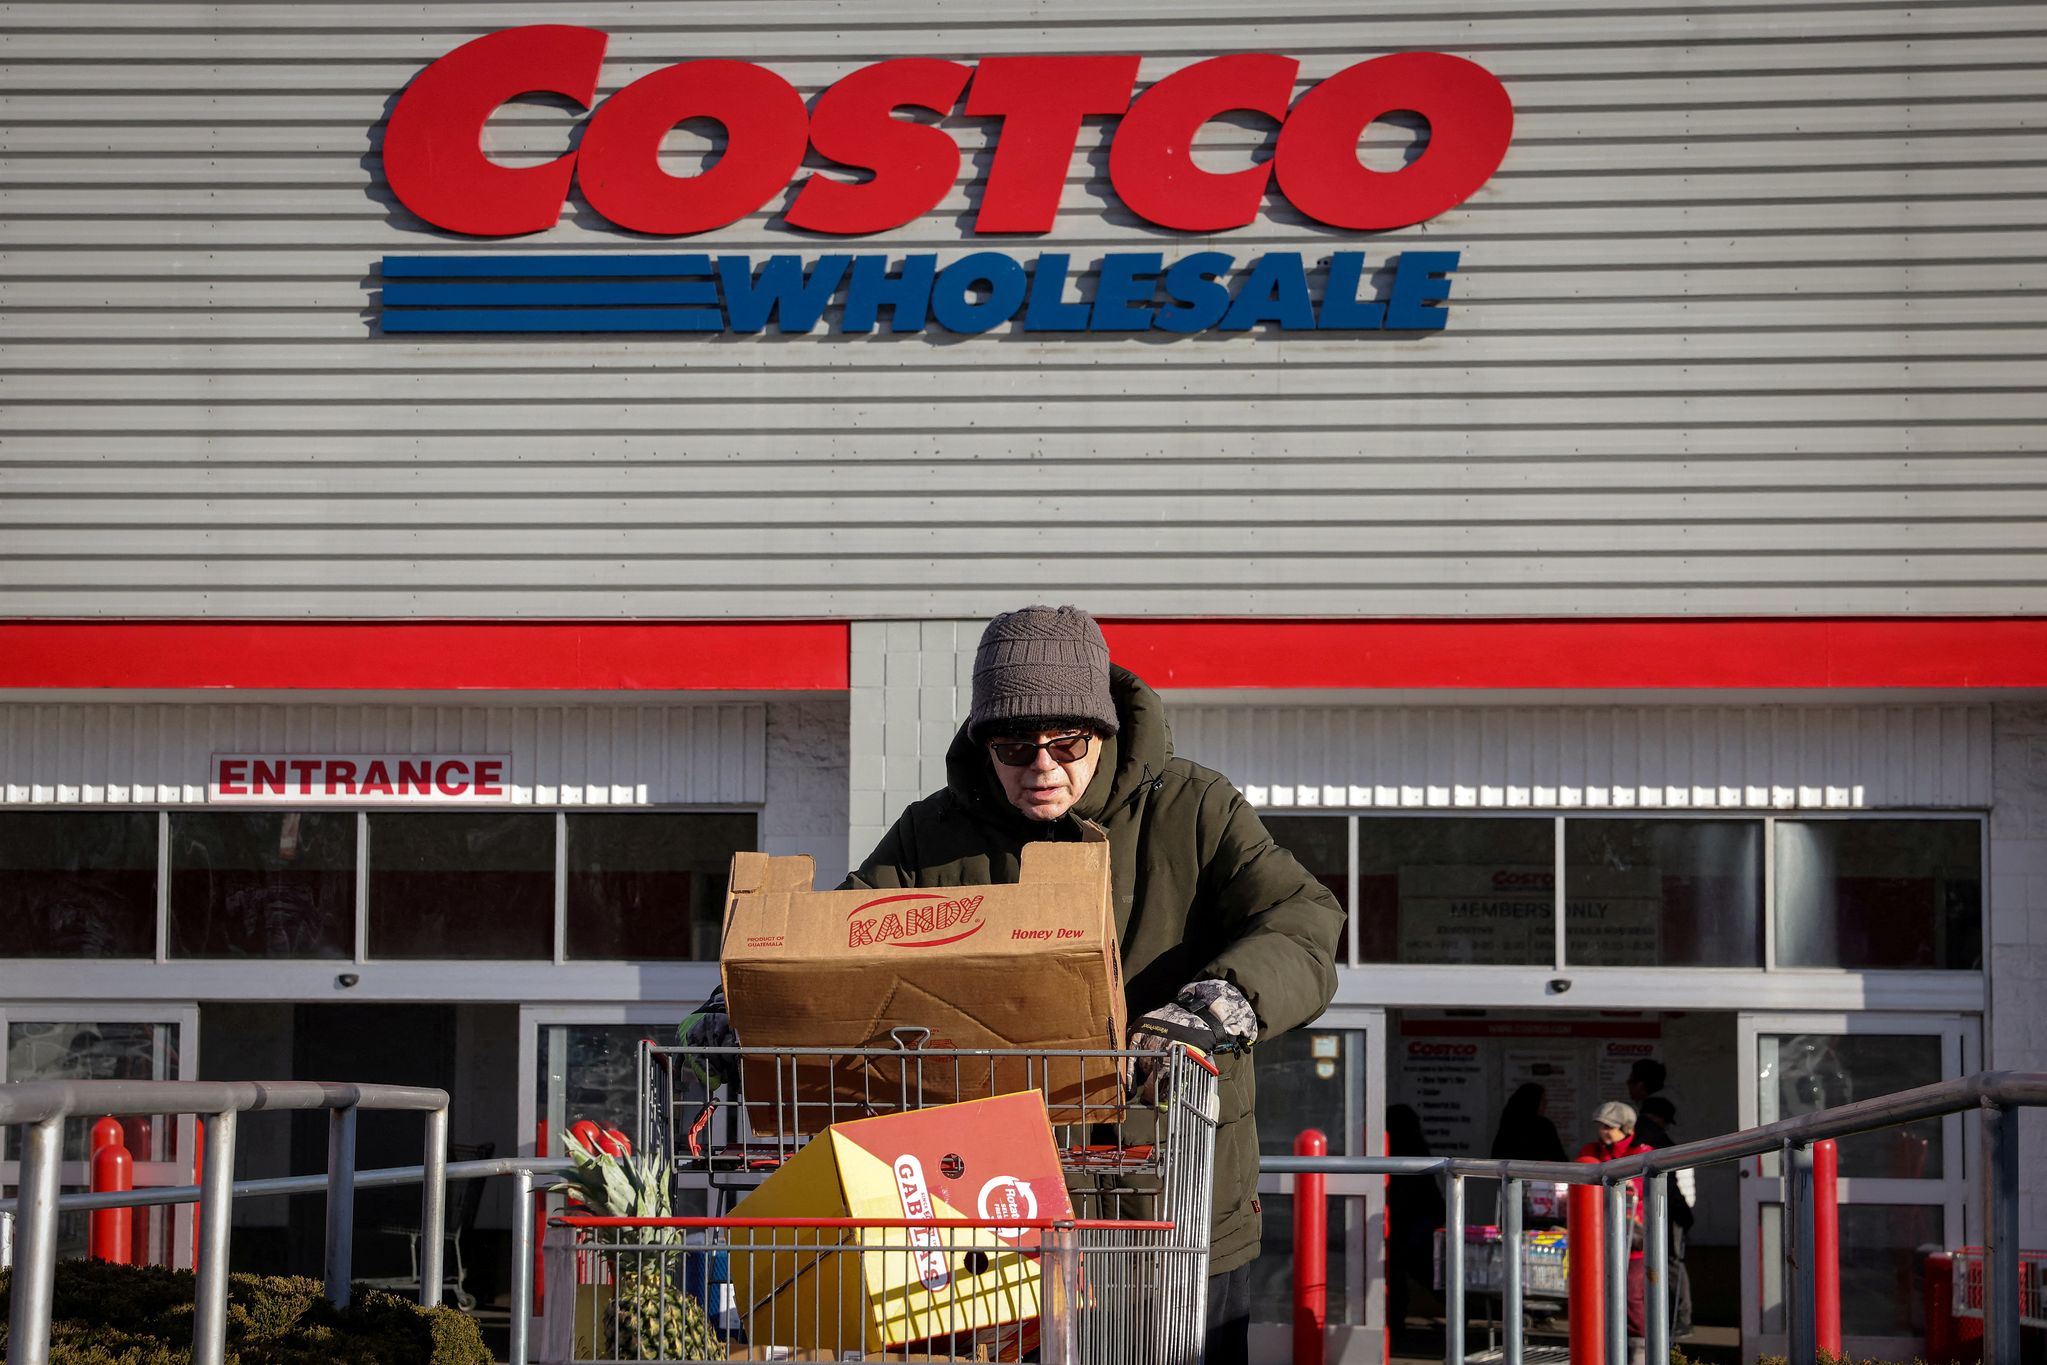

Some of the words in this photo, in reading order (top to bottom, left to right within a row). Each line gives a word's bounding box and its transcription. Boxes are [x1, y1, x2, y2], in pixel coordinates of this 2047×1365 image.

[383, 24, 1514, 236] COSTCO
[718, 252, 1461, 333] WHOLESALE
[219, 760, 502, 795] ENTRANCE
[849, 895, 984, 947] KANDY
[1450, 902, 1551, 918] MEMBERS
[1565, 903, 1608, 919] NLY
[1011, 928, 1053, 940] Honey
[1056, 928, 1084, 939] Dew
[899, 1164, 939, 1281] GABLA'S
[1005, 1189, 1020, 1219] Rotat
